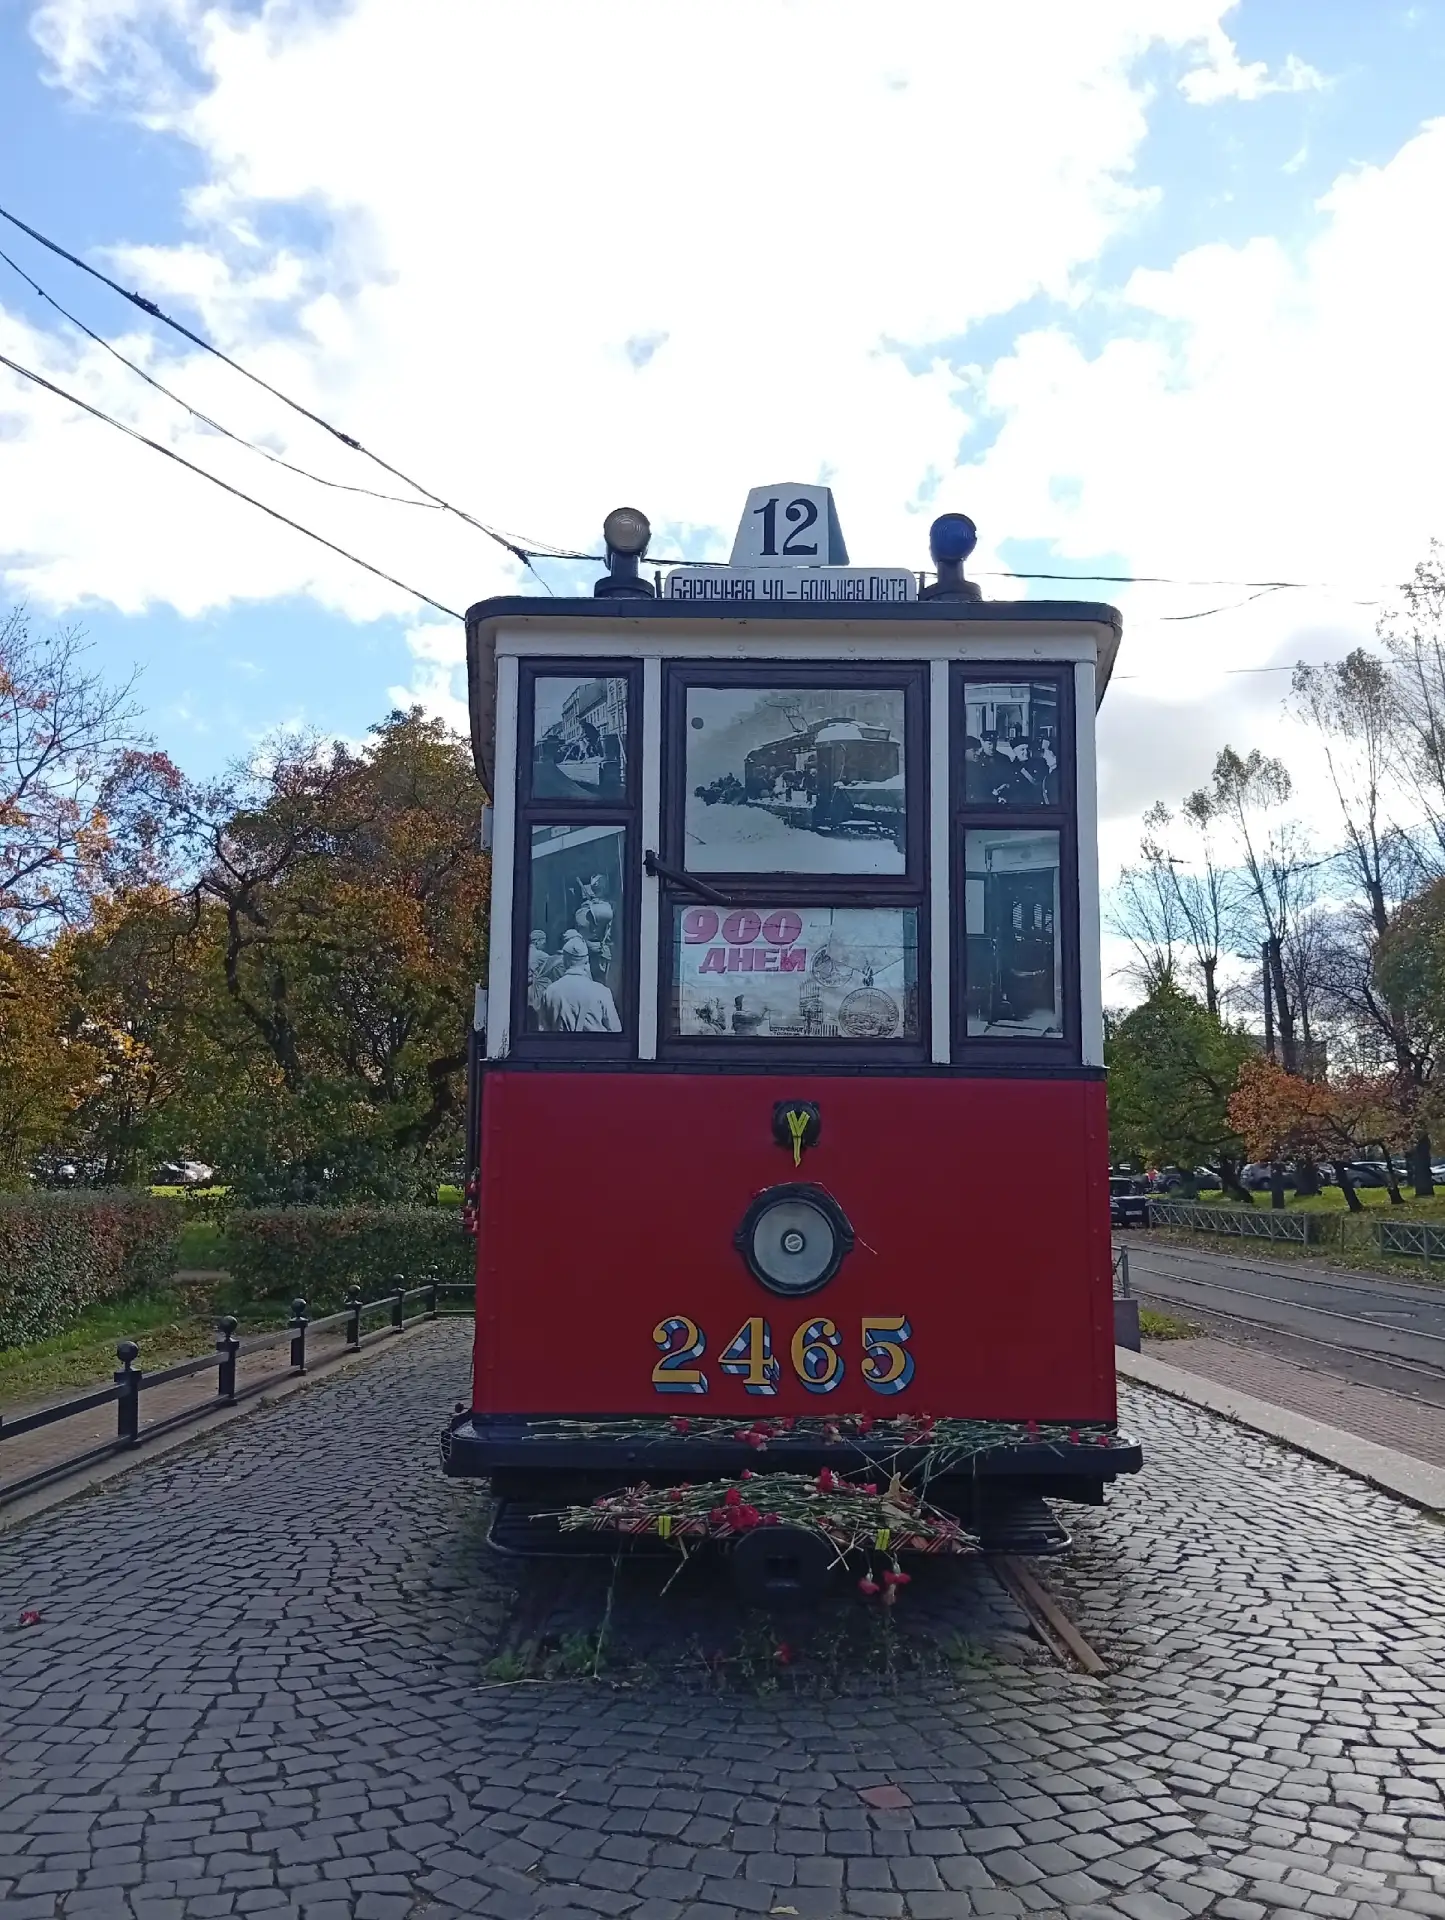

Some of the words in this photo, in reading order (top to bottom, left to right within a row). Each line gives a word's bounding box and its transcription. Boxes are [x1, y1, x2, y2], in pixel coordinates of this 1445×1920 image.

[753, 498, 818, 556] 12
[683, 907, 803, 946] 900
[698, 945, 807, 974] ДНЕЙ
[651, 1315, 915, 1395] 2465
